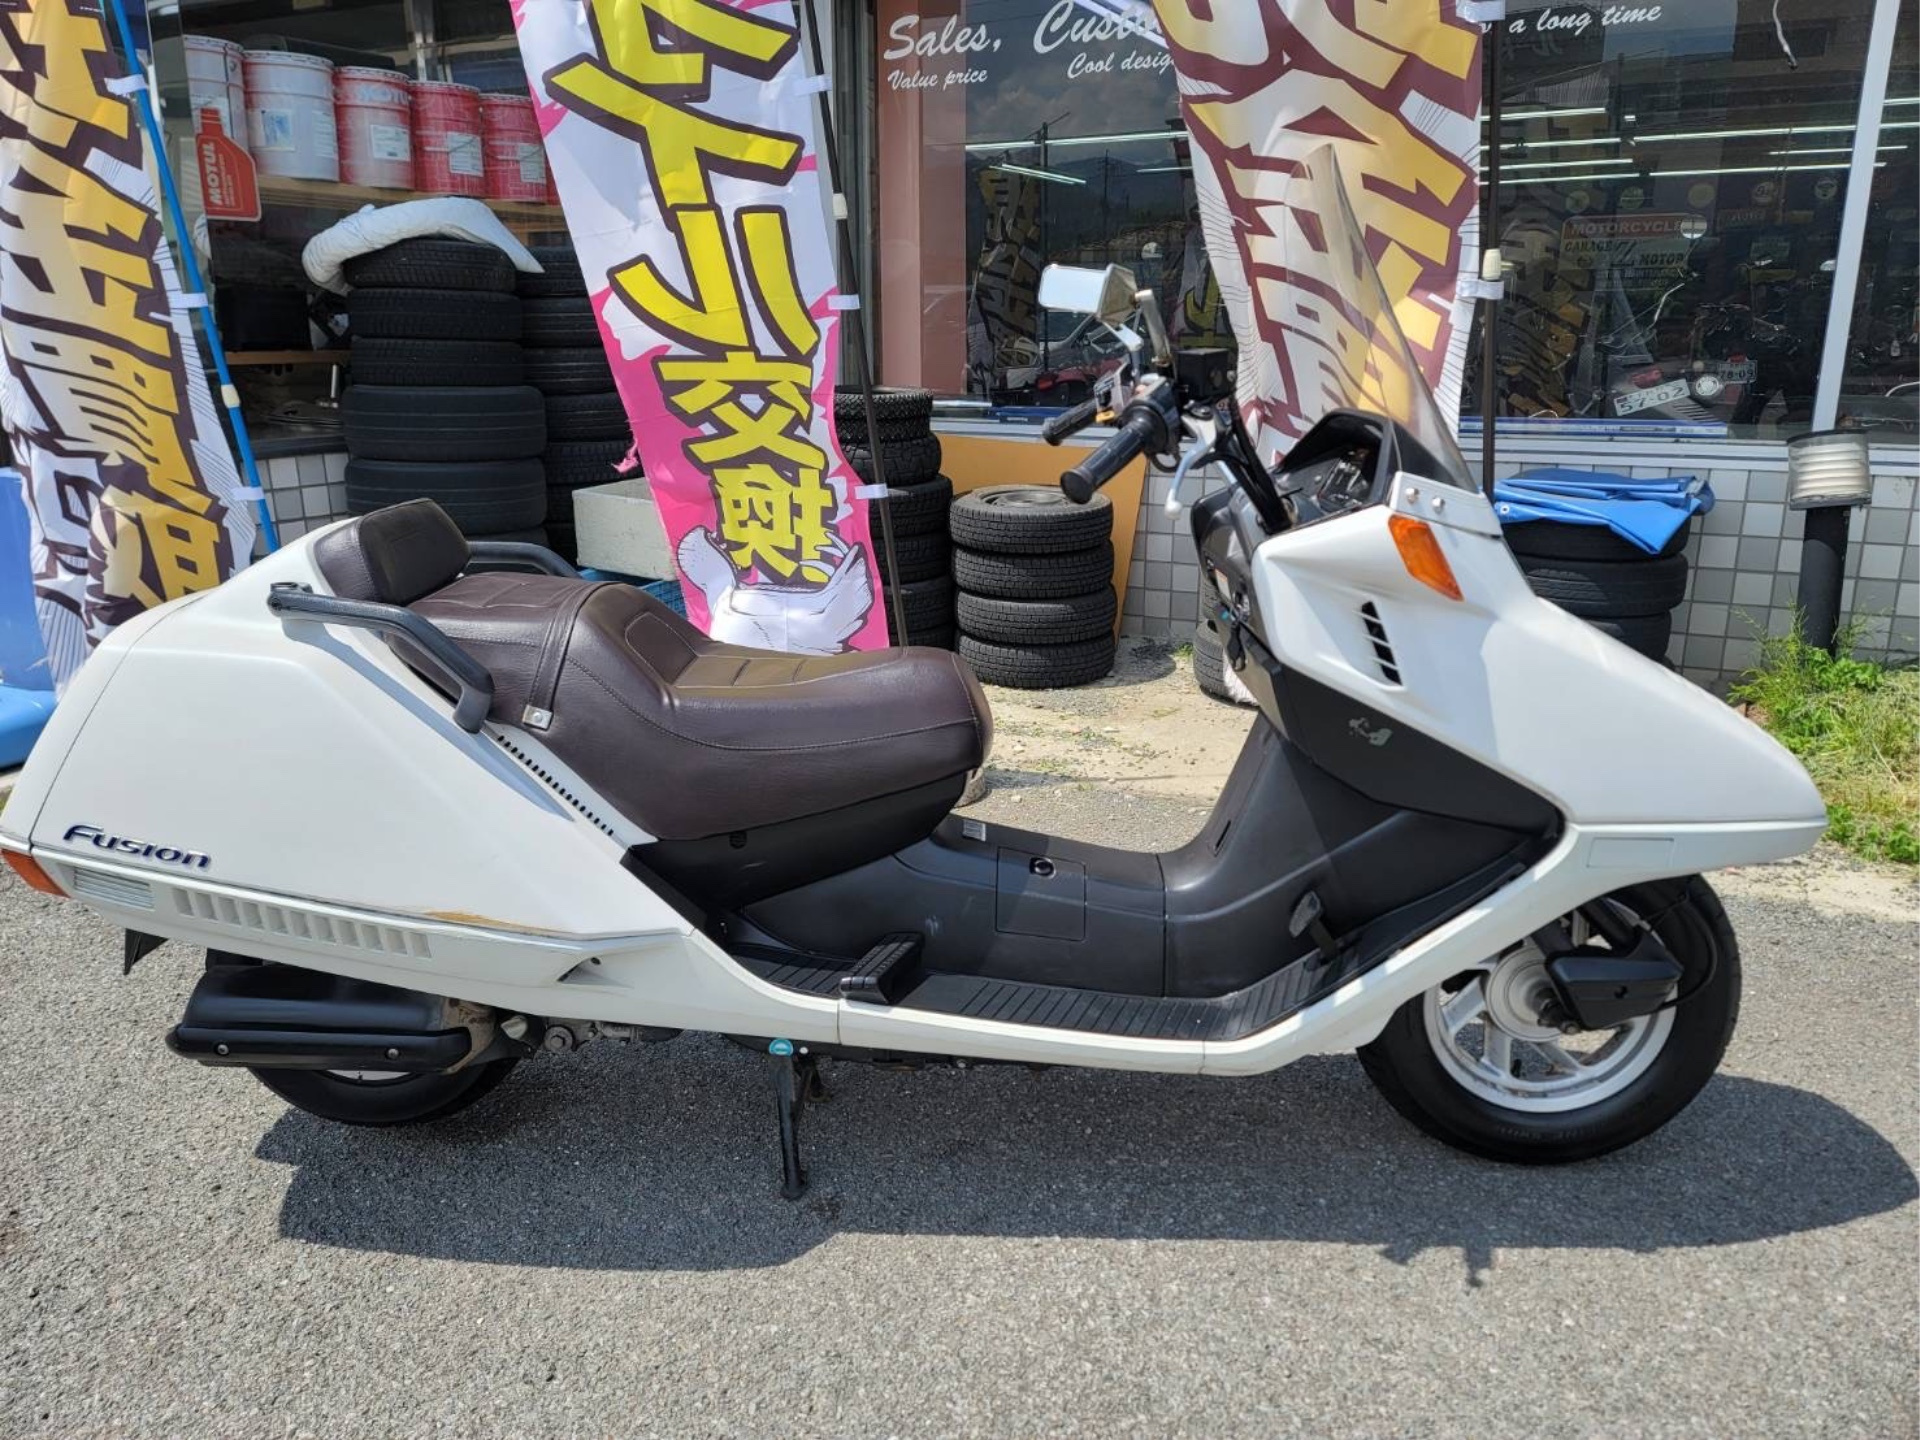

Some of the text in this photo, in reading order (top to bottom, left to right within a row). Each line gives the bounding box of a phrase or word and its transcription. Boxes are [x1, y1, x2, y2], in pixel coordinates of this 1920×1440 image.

[1508, 19, 1527, 33] a
[1536, 8, 1593, 36] long
[1601, 5, 1662, 26] time
[884, 14, 1001, 60] Sales,
[887, 68, 988, 91] Value price
[1067, 50, 1175, 79] Cool desig
[202, 142, 223, 206] MOTUL
[1619, 387, 1686, 414] 57-02
[63, 823, 212, 869] Fusion
